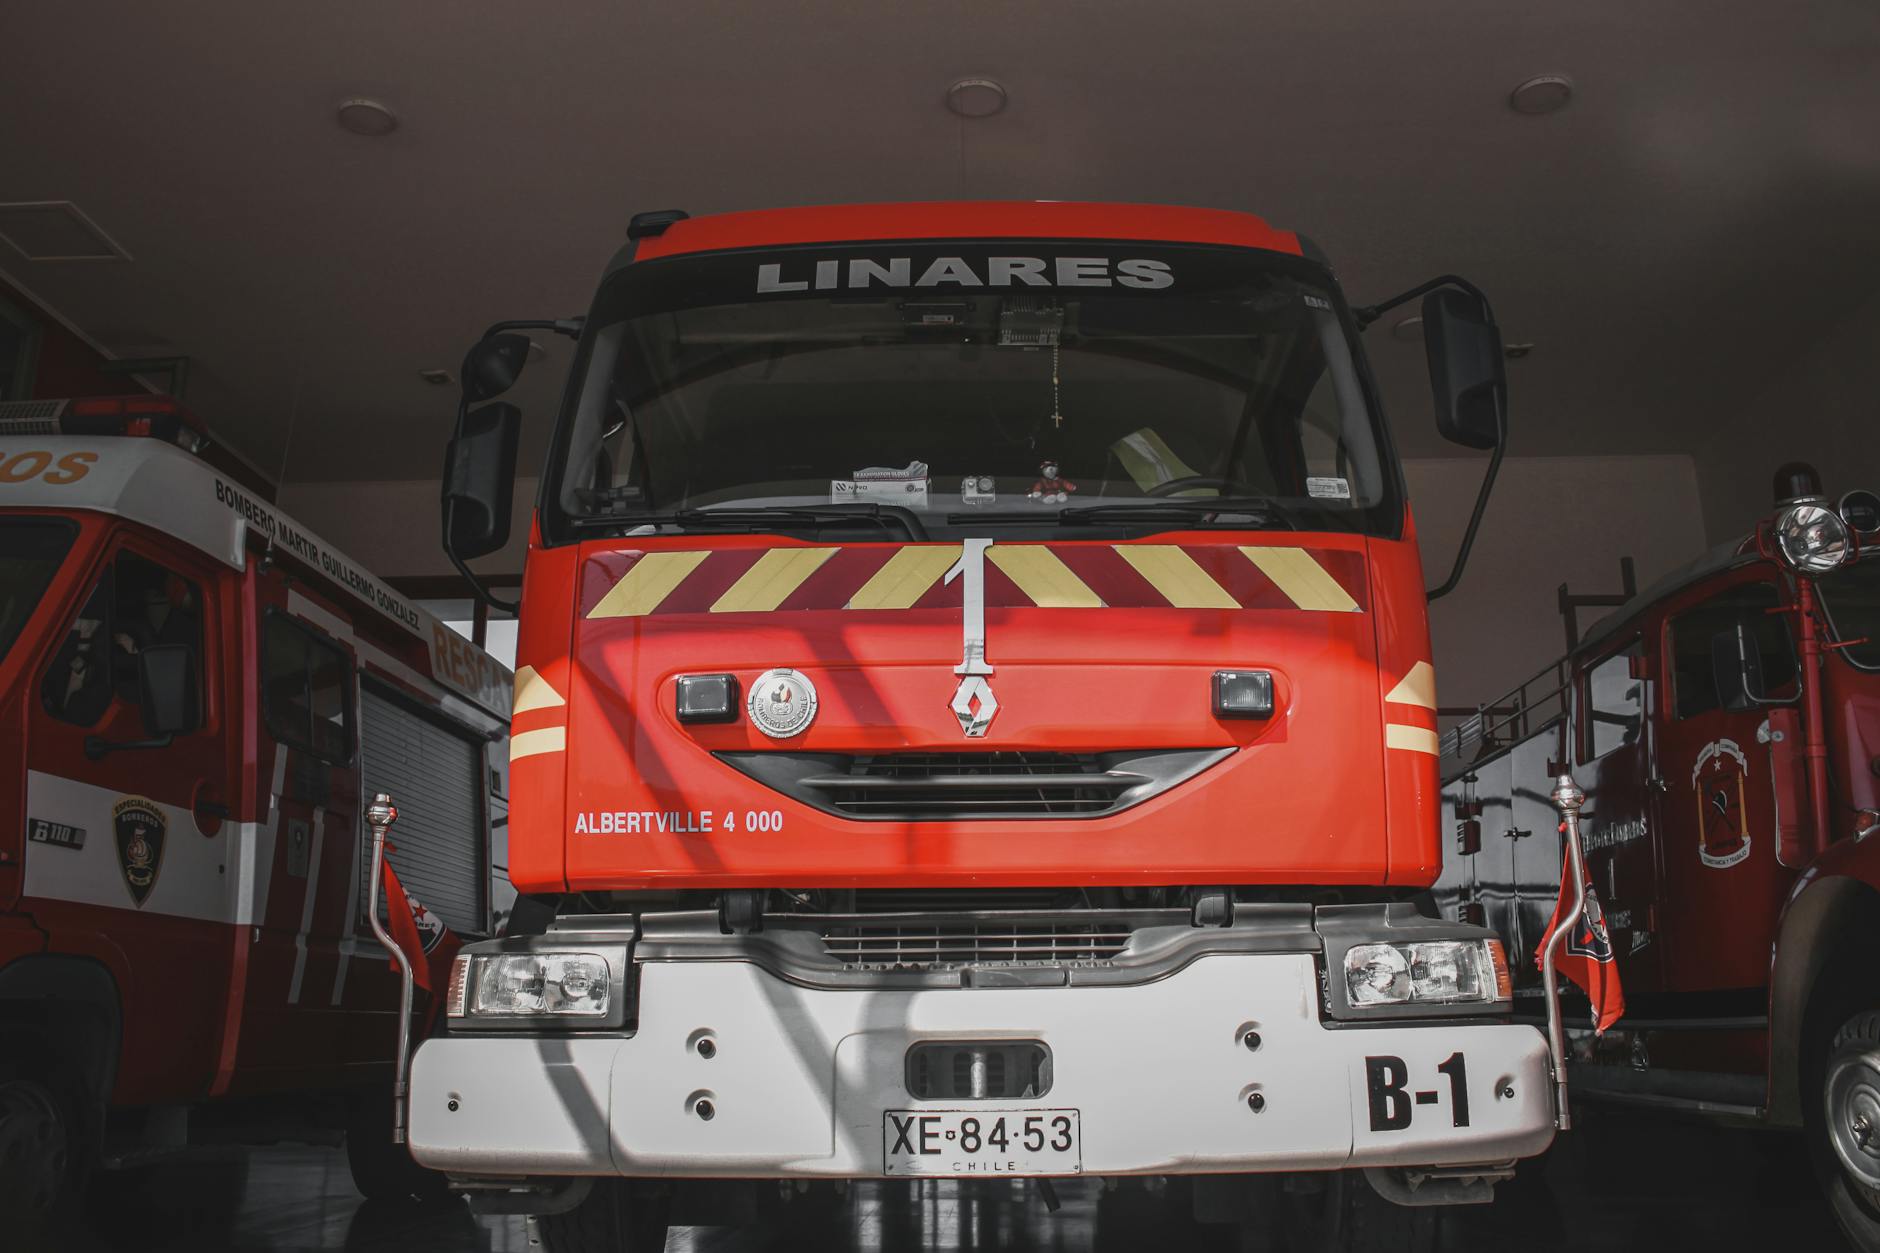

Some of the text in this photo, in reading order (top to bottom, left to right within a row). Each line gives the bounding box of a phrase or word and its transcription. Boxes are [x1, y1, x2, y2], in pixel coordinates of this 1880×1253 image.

[757, 257, 1175, 293] LINARES
[0, 451, 99, 484] OS
[215, 479, 420, 630] BOMBERO MARTIR GUILLERMO GONZALEZ
[944, 538, 994, 674] 1
[787, 717, 799, 727] DE
[574, 810, 783, 833] ALBERTVILLE 4 000
[1365, 1051, 1470, 1132] B-1
[952, 1161, 1016, 1171] CHILE
